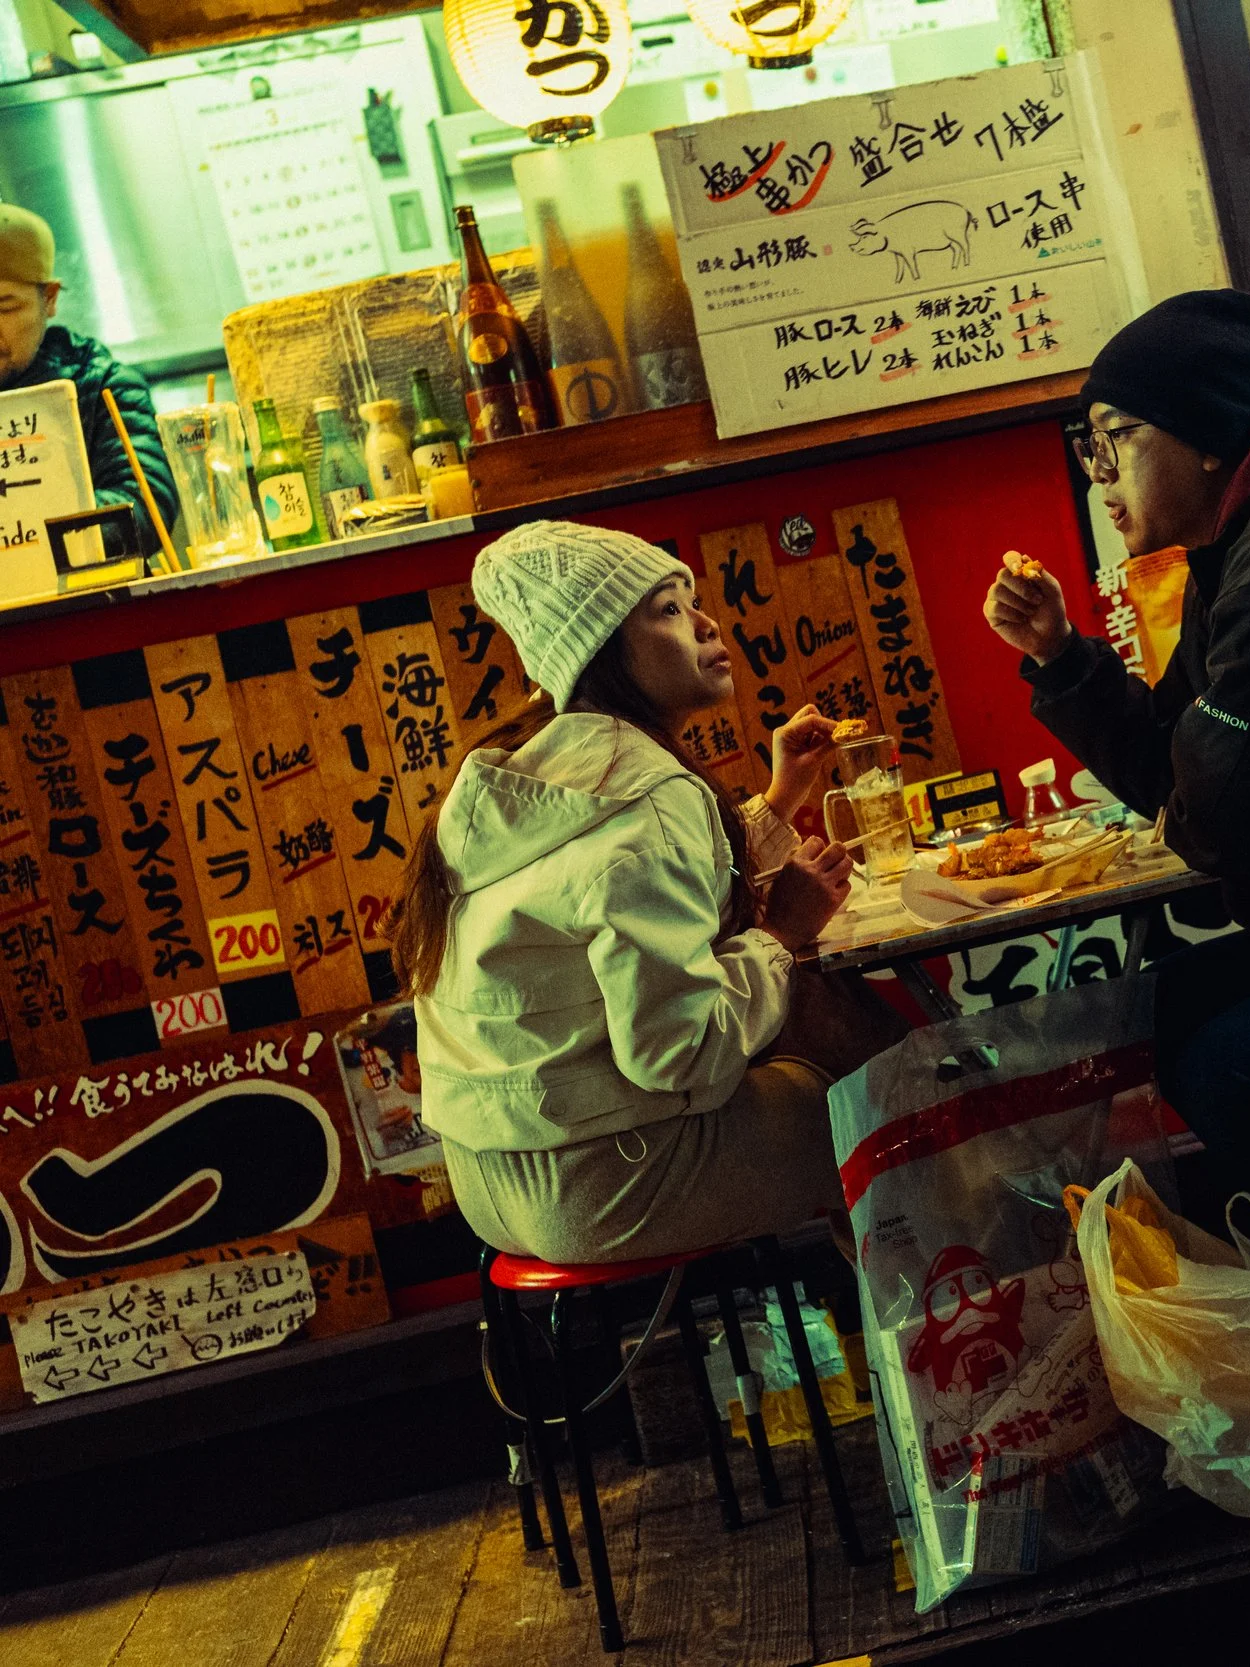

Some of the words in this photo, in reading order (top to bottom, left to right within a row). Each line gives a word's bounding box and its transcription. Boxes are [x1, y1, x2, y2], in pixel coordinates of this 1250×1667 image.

[700, 142, 773, 198] 極上
[755, 141, 832, 213] 串かつ
[849, 111, 967, 187] 盛合せ
[730, 234, 818, 272] 山形豚
[1020, 213, 1073, 249] 使用
[774, 314, 866, 350] 豚ロース
[873, 311, 905, 334] 2本
[1010, 283, 1046, 305] 1本
[931, 311, 1003, 348] 玉ねぎ
[1016, 309, 1052, 332] 1本
[785, 350, 873, 392] 豚ヒレ
[883, 348, 919, 371] 2本
[1022, 331, 1059, 354] 1本
[278, 482, 296, 500] 참
[796, 615, 856, 658] Onion
[717, 548, 790, 774] れんこ
[1198, 699, 1250, 732] FASHION
[310, 628, 407, 862] チーズ
[161, 671, 252, 900] アスパラ
[214, 921, 281, 963] 200
[154, 993, 223, 1038] 200
[76, 1314, 183, 1354] TAKOYAKI
[206, 1306, 243, 1325] Left
